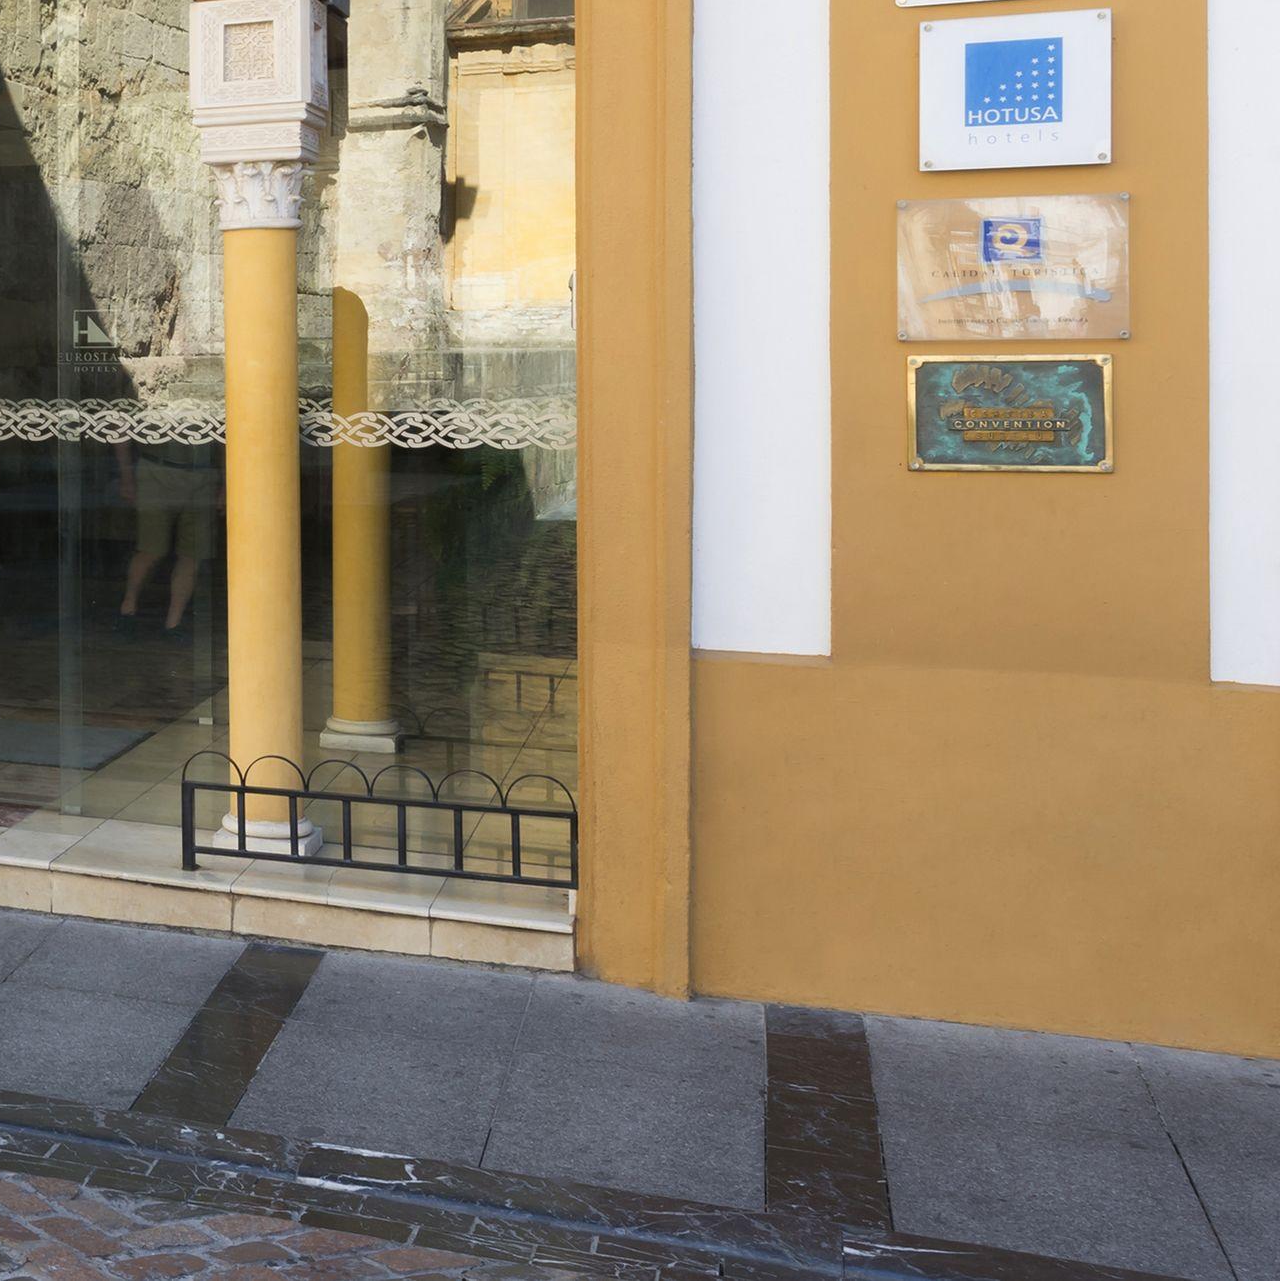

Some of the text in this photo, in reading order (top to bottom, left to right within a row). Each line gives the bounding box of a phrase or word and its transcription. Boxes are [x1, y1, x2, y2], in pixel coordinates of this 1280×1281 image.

[968, 106, 1058, 124] HOTUSA
[968, 129, 1059, 145] hotels
[953, 420, 1066, 429] CONVENTION
